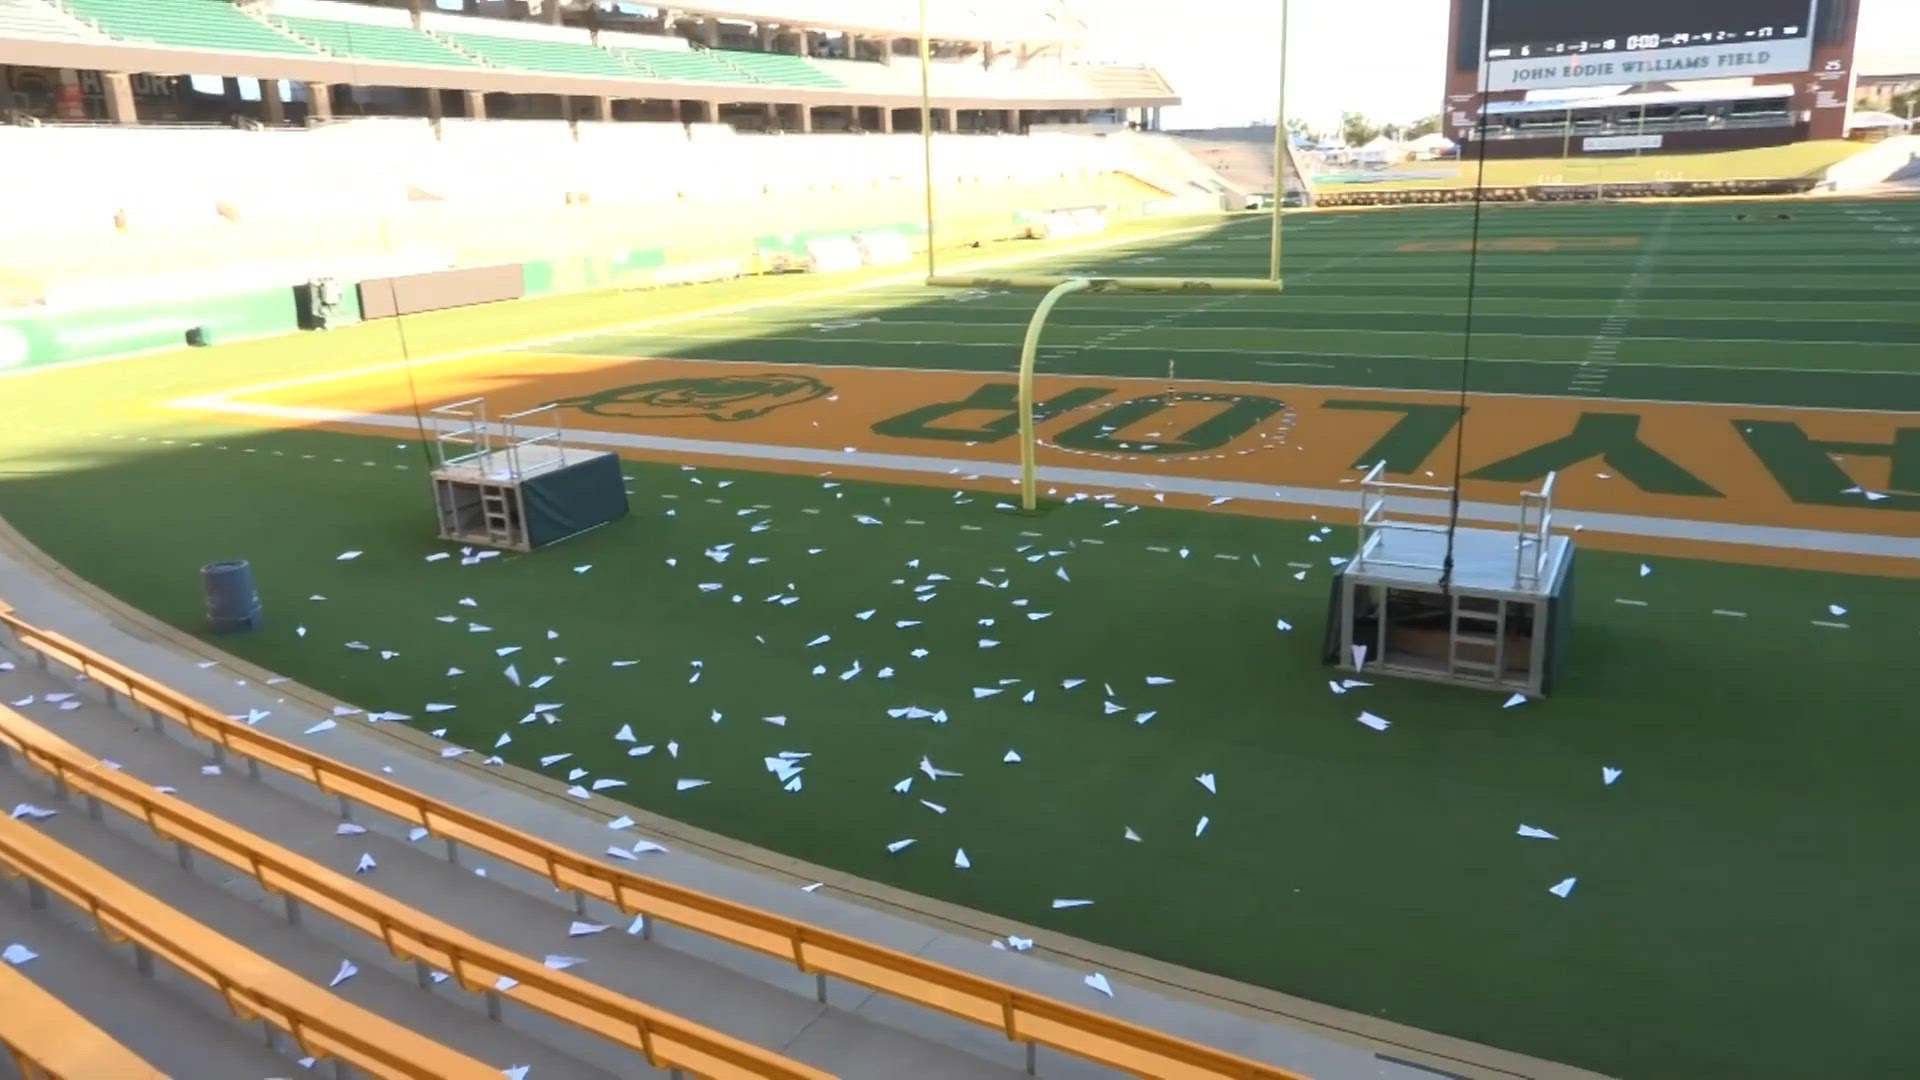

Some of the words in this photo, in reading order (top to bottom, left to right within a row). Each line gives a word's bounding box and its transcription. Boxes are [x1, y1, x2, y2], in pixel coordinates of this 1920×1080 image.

[1512, 66, 1556, 83] JOHN
[1563, 62, 1613, 77] EDDIE
[1622, 55, 1709, 74] WILLIAMS
[1717, 51, 1771, 67] FIELD
